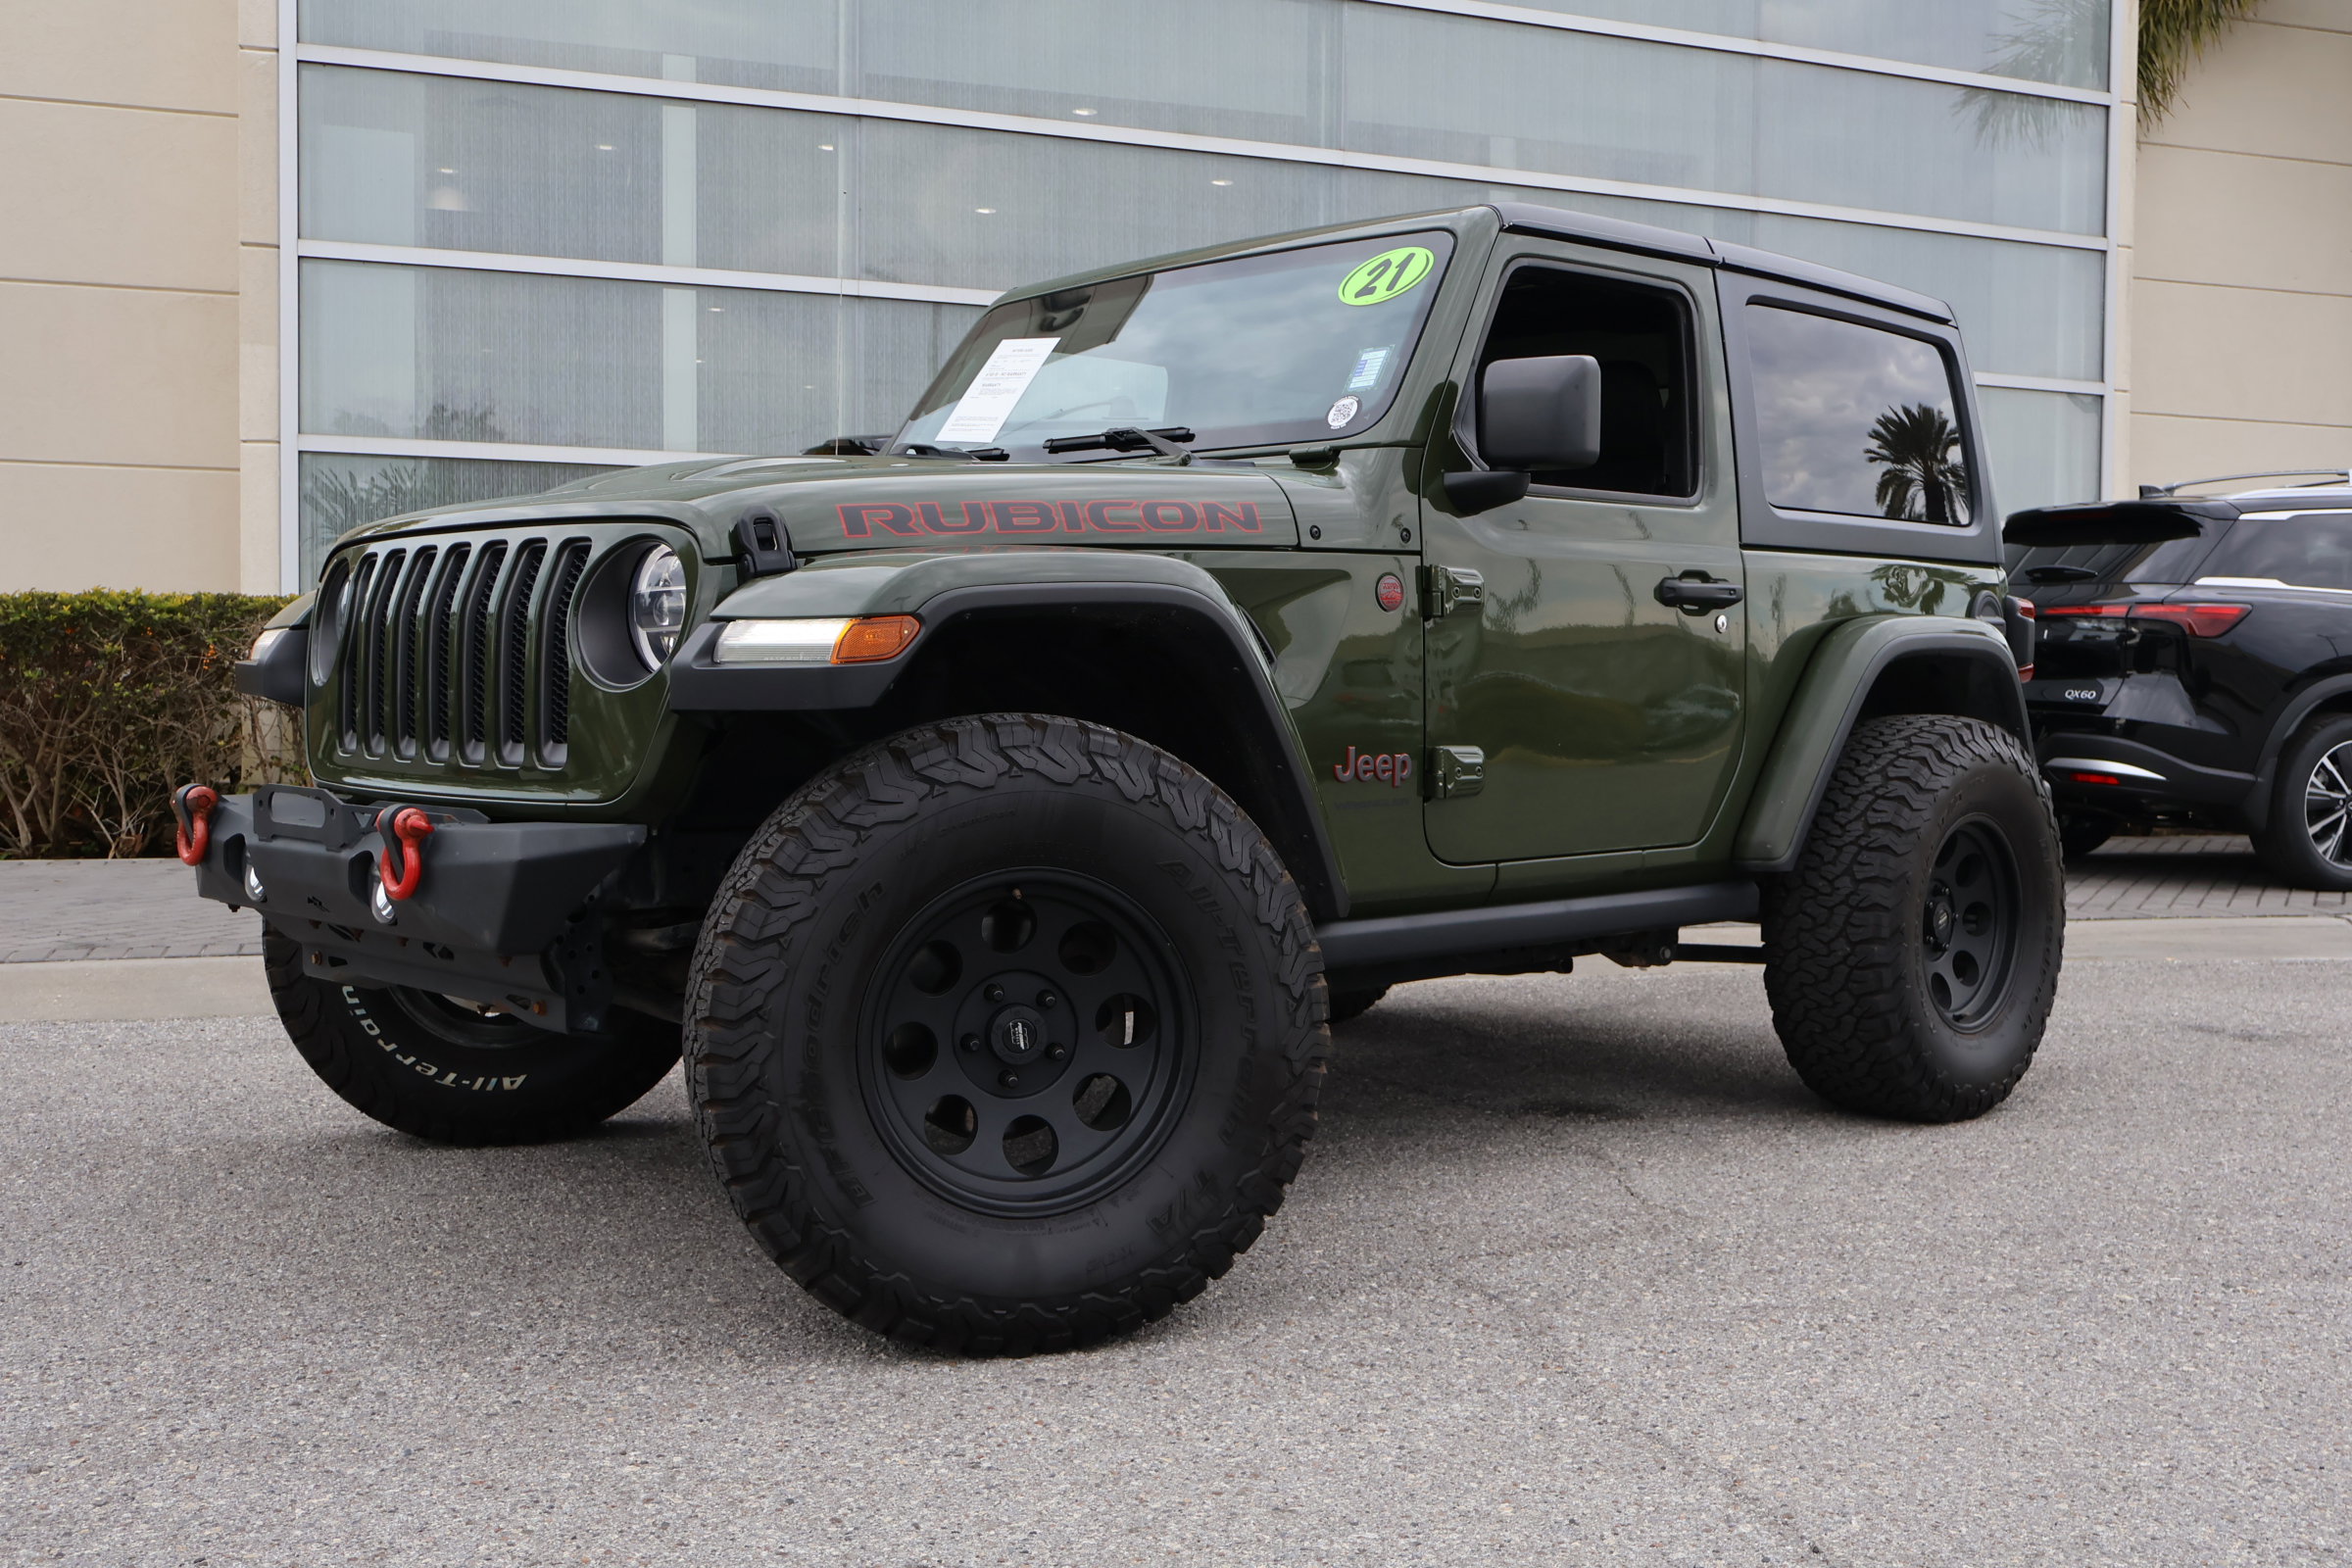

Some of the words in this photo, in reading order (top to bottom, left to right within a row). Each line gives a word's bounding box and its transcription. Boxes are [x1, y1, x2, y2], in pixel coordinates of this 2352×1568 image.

[1354, 253, 1416, 299] 21
[836, 500, 1262, 538] RUBICON
[2065, 689, 2096, 700] QX60
[1333, 745, 1412, 788] Jeep
